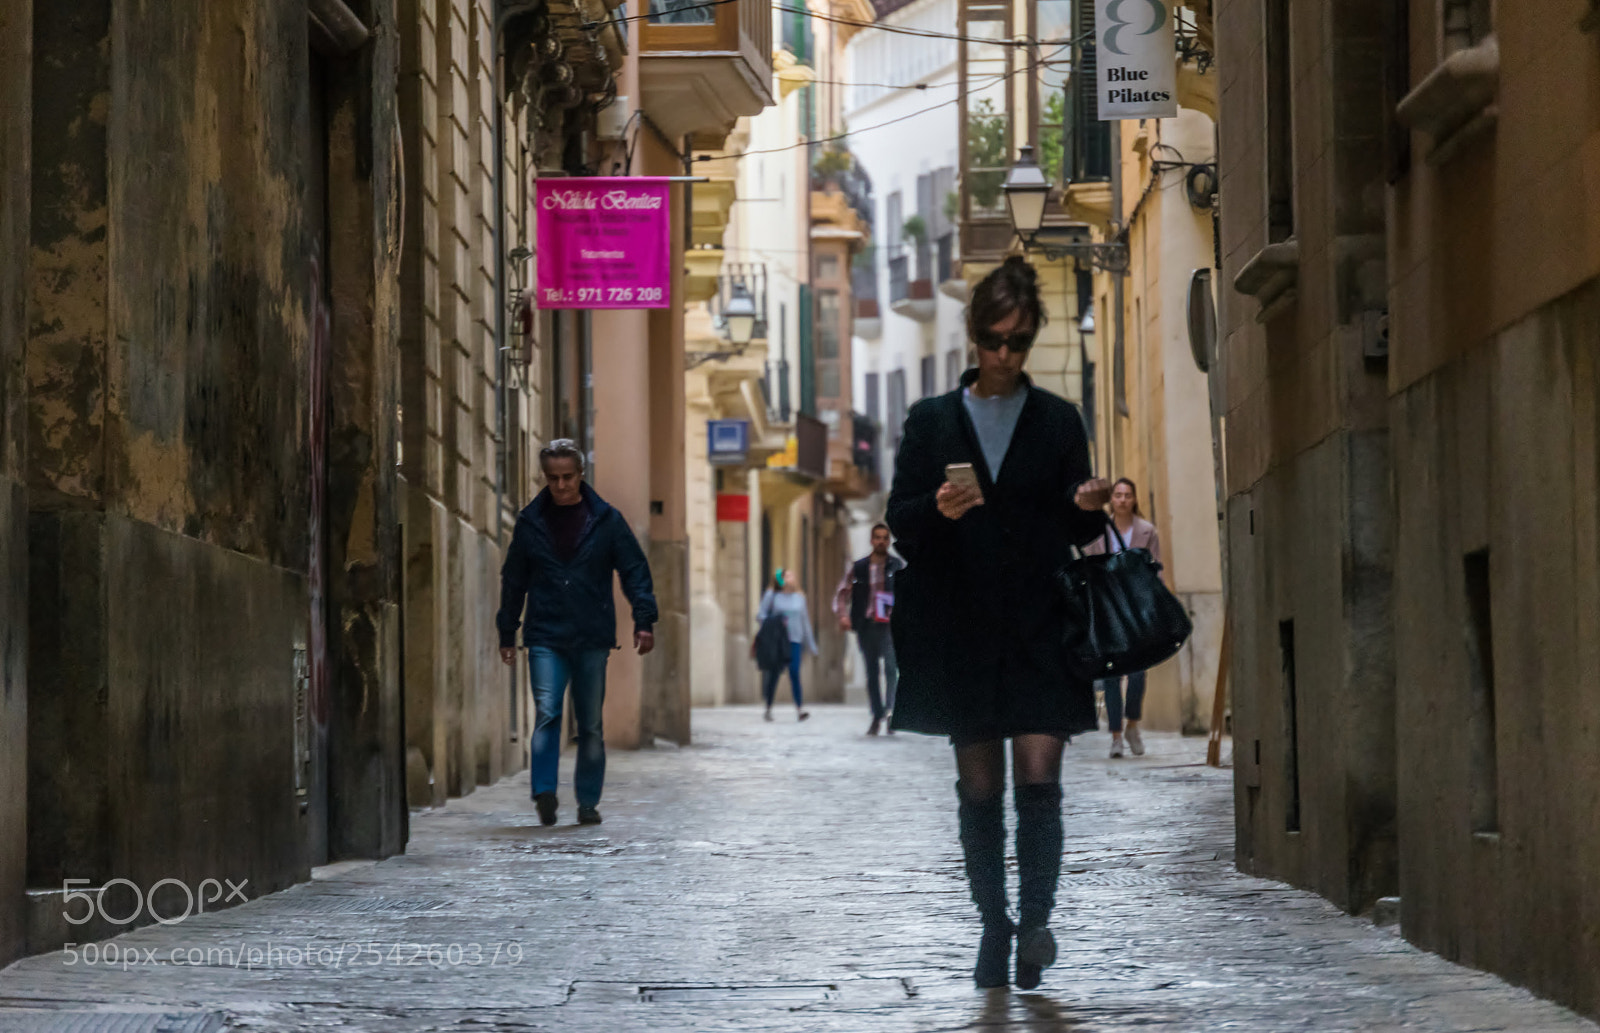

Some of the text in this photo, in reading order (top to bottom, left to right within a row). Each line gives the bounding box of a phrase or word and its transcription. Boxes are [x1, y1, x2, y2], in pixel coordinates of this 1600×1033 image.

[1107, 67, 1148, 82] Blue
[1108, 88, 1170, 103] Pilates
[544, 287, 662, 301] Tel.: 971 726 208
